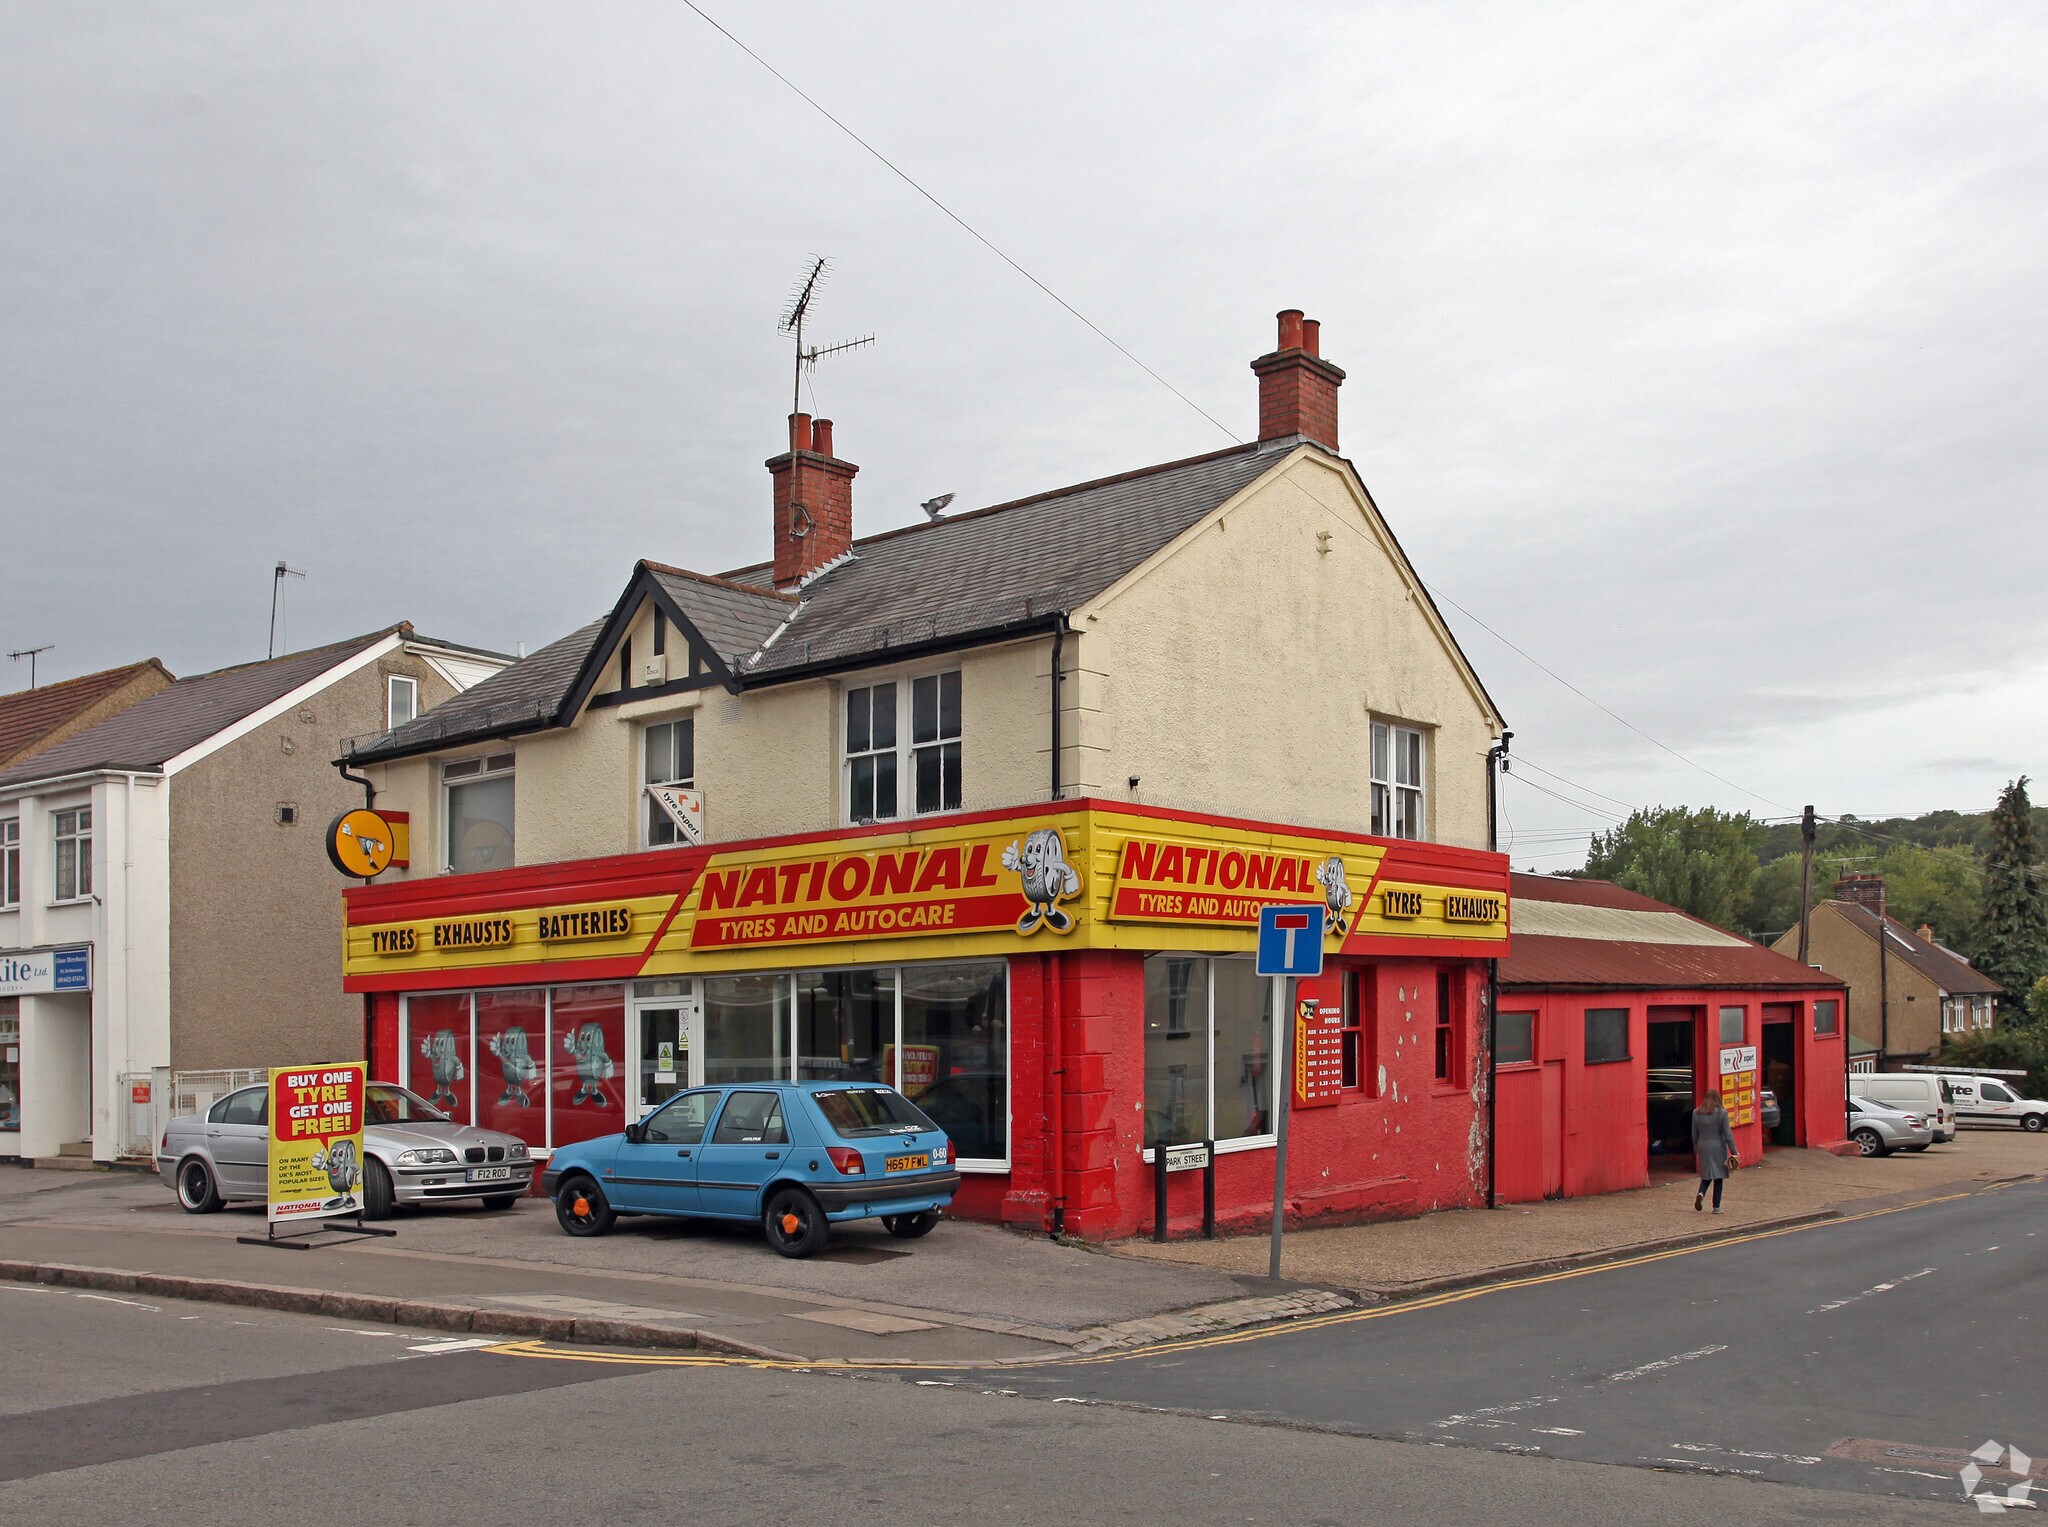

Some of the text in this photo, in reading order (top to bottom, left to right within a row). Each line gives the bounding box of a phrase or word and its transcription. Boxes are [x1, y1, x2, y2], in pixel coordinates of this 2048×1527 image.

[663, 792, 700, 836] tyre expert
[1122, 841, 1316, 893] NATIONAL
[699, 844, 998, 912] NATIONAL
[1138, 893, 1294, 918] TYRES AND AUTO
[1386, 890, 1500, 921] TYRES EXHAUSTS
[372, 908, 628, 952] TYRES EXHAUSTS BATTERIES
[720, 904, 955, 940] TYRES AND AUTOCARE
[0, 958, 31, 982] ite
[288, 1071, 352, 1087] BUY ONE
[294, 1084, 347, 1104] TYRE
[289, 1101, 352, 1118] GET ONE
[292, 1115, 351, 1136] FREE!
[886, 1159, 909, 1171] H657
[911, 1157, 928, 1168] FWL
[933, 1148, 946, 1159] 0-60
[1166, 1154, 1206, 1166] PARK STREET
[478, 1170, 490, 1179] F12
[277, 1202, 322, 1210] NATIONAL
